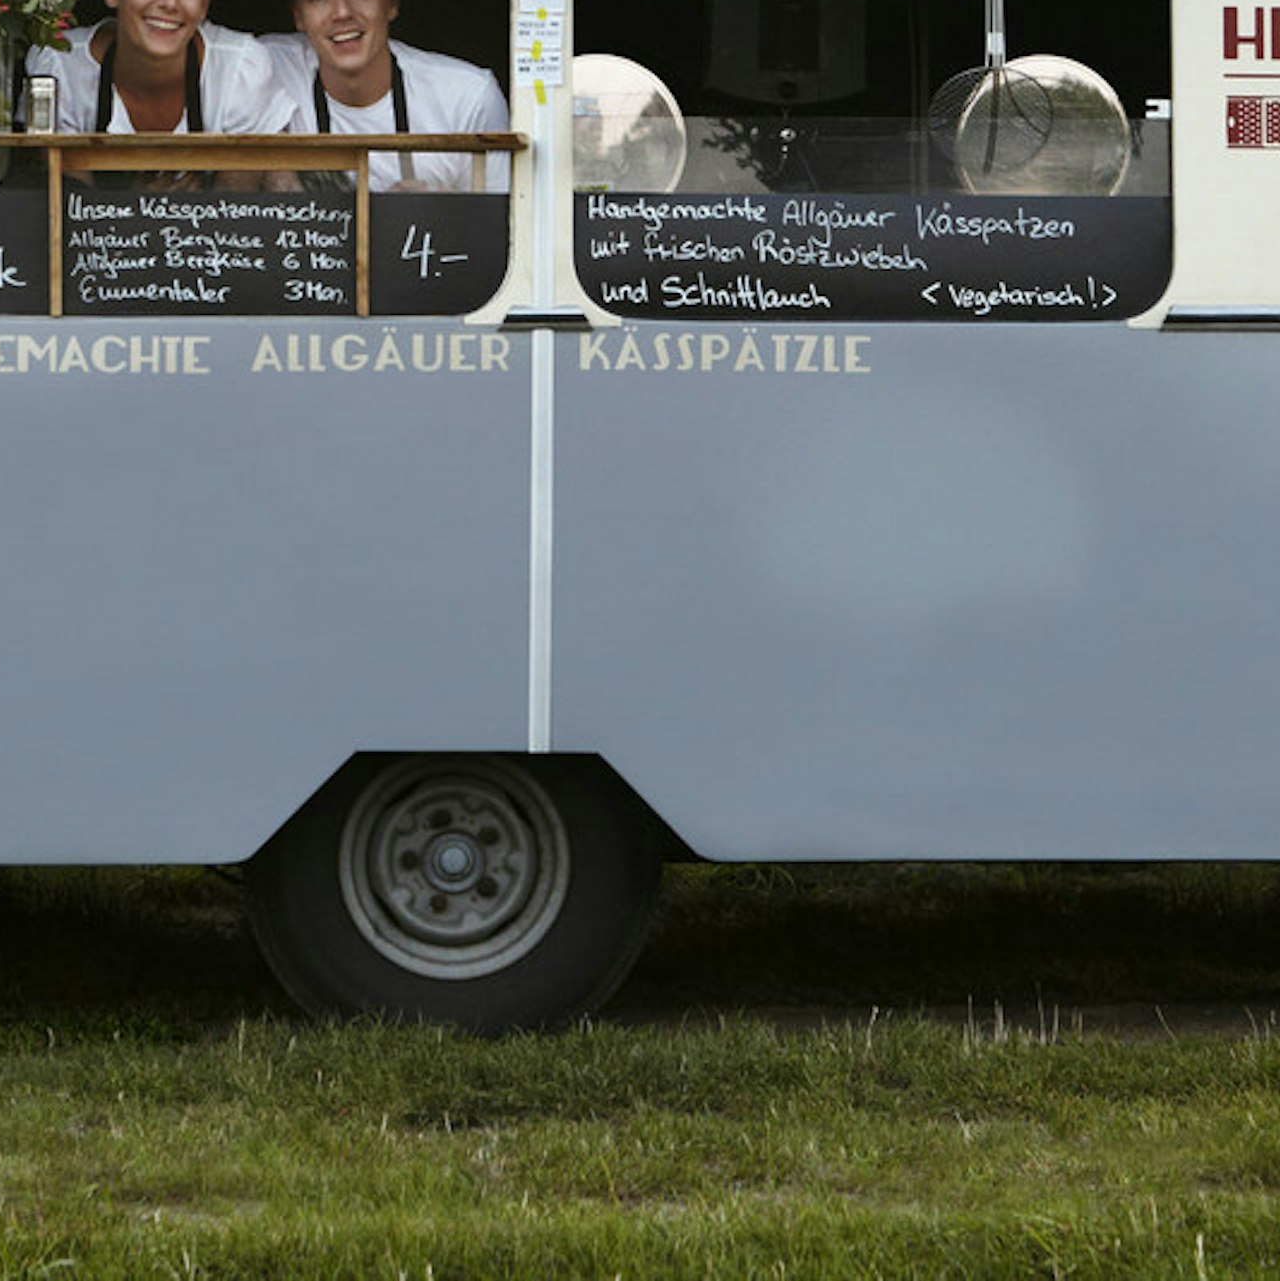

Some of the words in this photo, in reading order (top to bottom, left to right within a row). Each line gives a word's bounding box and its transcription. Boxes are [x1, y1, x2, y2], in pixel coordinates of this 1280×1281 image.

[587, 195, 768, 232] Handgemachte
[782, 199, 897, 249] Allgäuer
[915, 202, 1076, 245] Kässpatzen
[274, 229, 303, 250] 12
[590, 231, 631, 260] mit
[642, 231, 746, 263] frischen
[281, 252, 300, 271] 6
[79, 275, 232, 304] Emmentaler
[283, 279, 305, 301] 3
[601, 277, 649, 305] und
[660, 271, 832, 311] Schnittlauch
[250, 328, 511, 374] ALLGÄUER
[579, 326, 871, 374] KÄSSPÄTZLE
